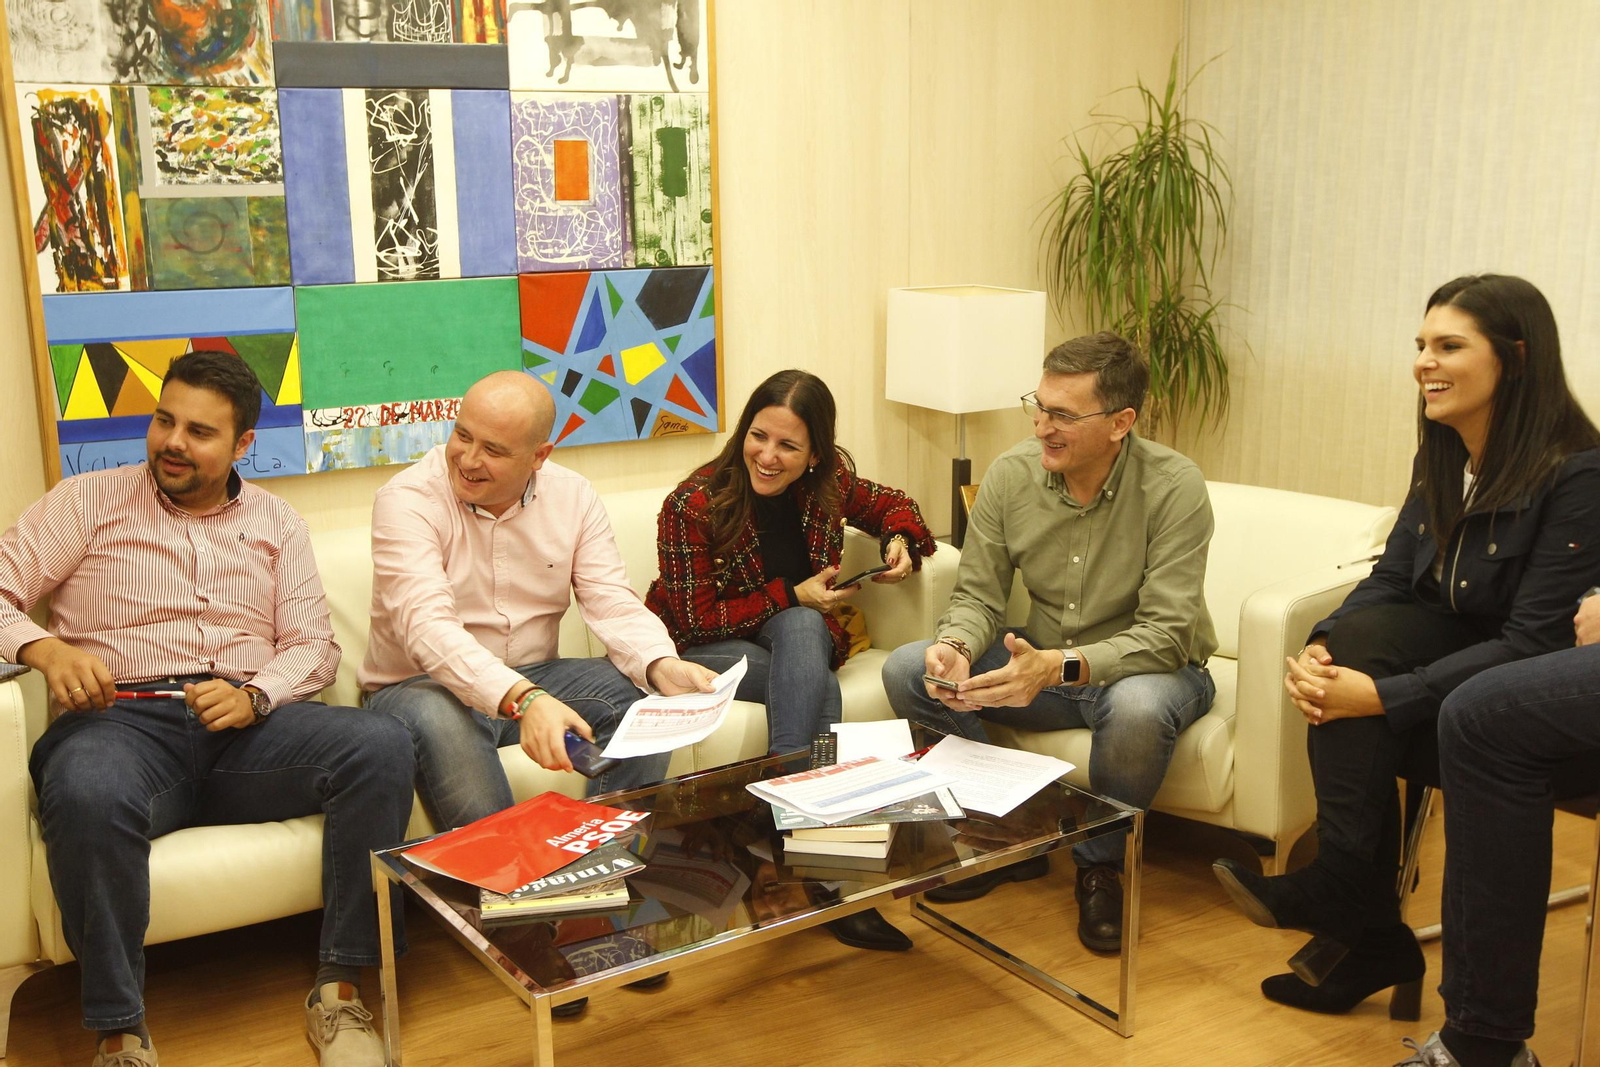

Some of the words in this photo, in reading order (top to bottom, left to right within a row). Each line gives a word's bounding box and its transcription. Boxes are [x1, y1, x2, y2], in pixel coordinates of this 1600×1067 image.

[343, 407, 366, 429] 22
[381, 403, 402, 427] DE
[561, 810, 652, 854] PSOE
